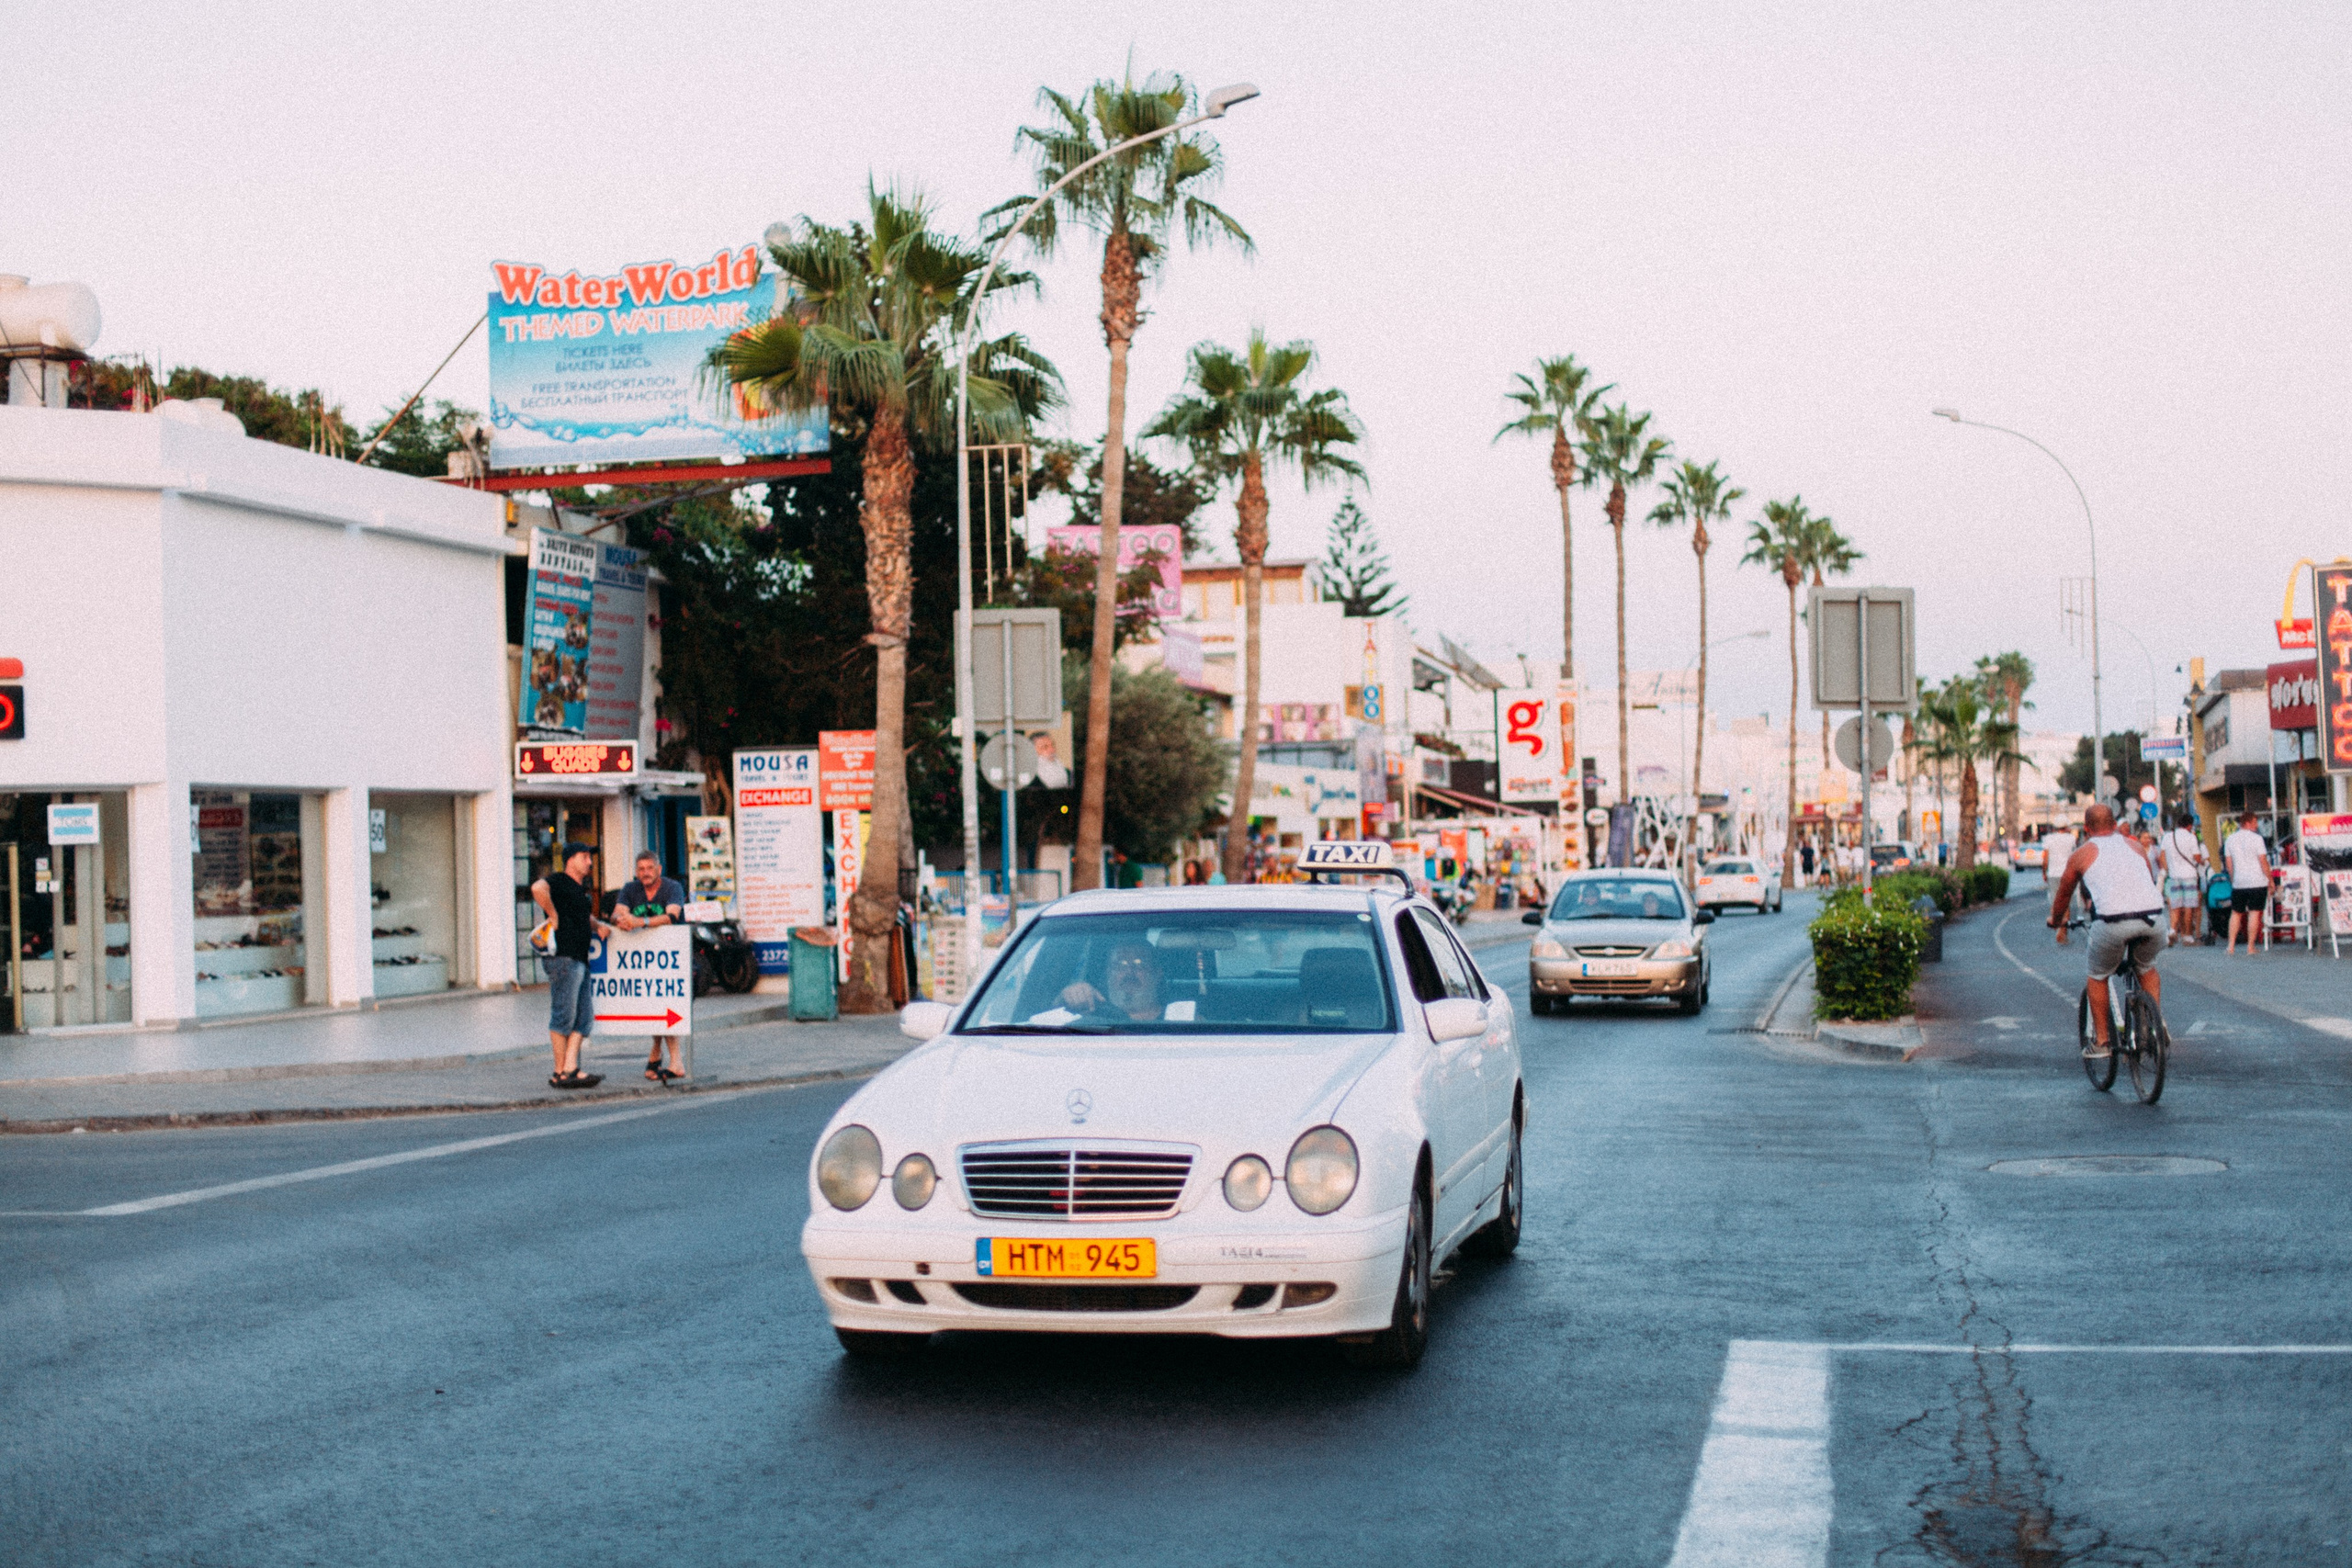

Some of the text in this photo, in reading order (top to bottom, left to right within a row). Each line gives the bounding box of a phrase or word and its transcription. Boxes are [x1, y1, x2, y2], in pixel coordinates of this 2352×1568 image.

[492, 244, 758, 306] WaterWorld
[499, 302, 750, 343] THEMED WATERPARK
[563, 343, 643, 358] TICKETS HERE
[531, 377, 676, 394] FREE TRANSPORTATION
[612, 389, 688, 403] ТРАНСПОРТ
[1363, 622, 1379, 718] TATTOO
[740, 754, 808, 772] MOUSA
[741, 790, 809, 804] EXCHANGE
[1311, 845, 1378, 863] TAXI
[616, 950, 680, 970] ΧΩΡΟΣ
[590, 978, 685, 998] ΤΑΘΜΕΥΣΗΣ
[1008, 1243, 1140, 1271] HTM 945
